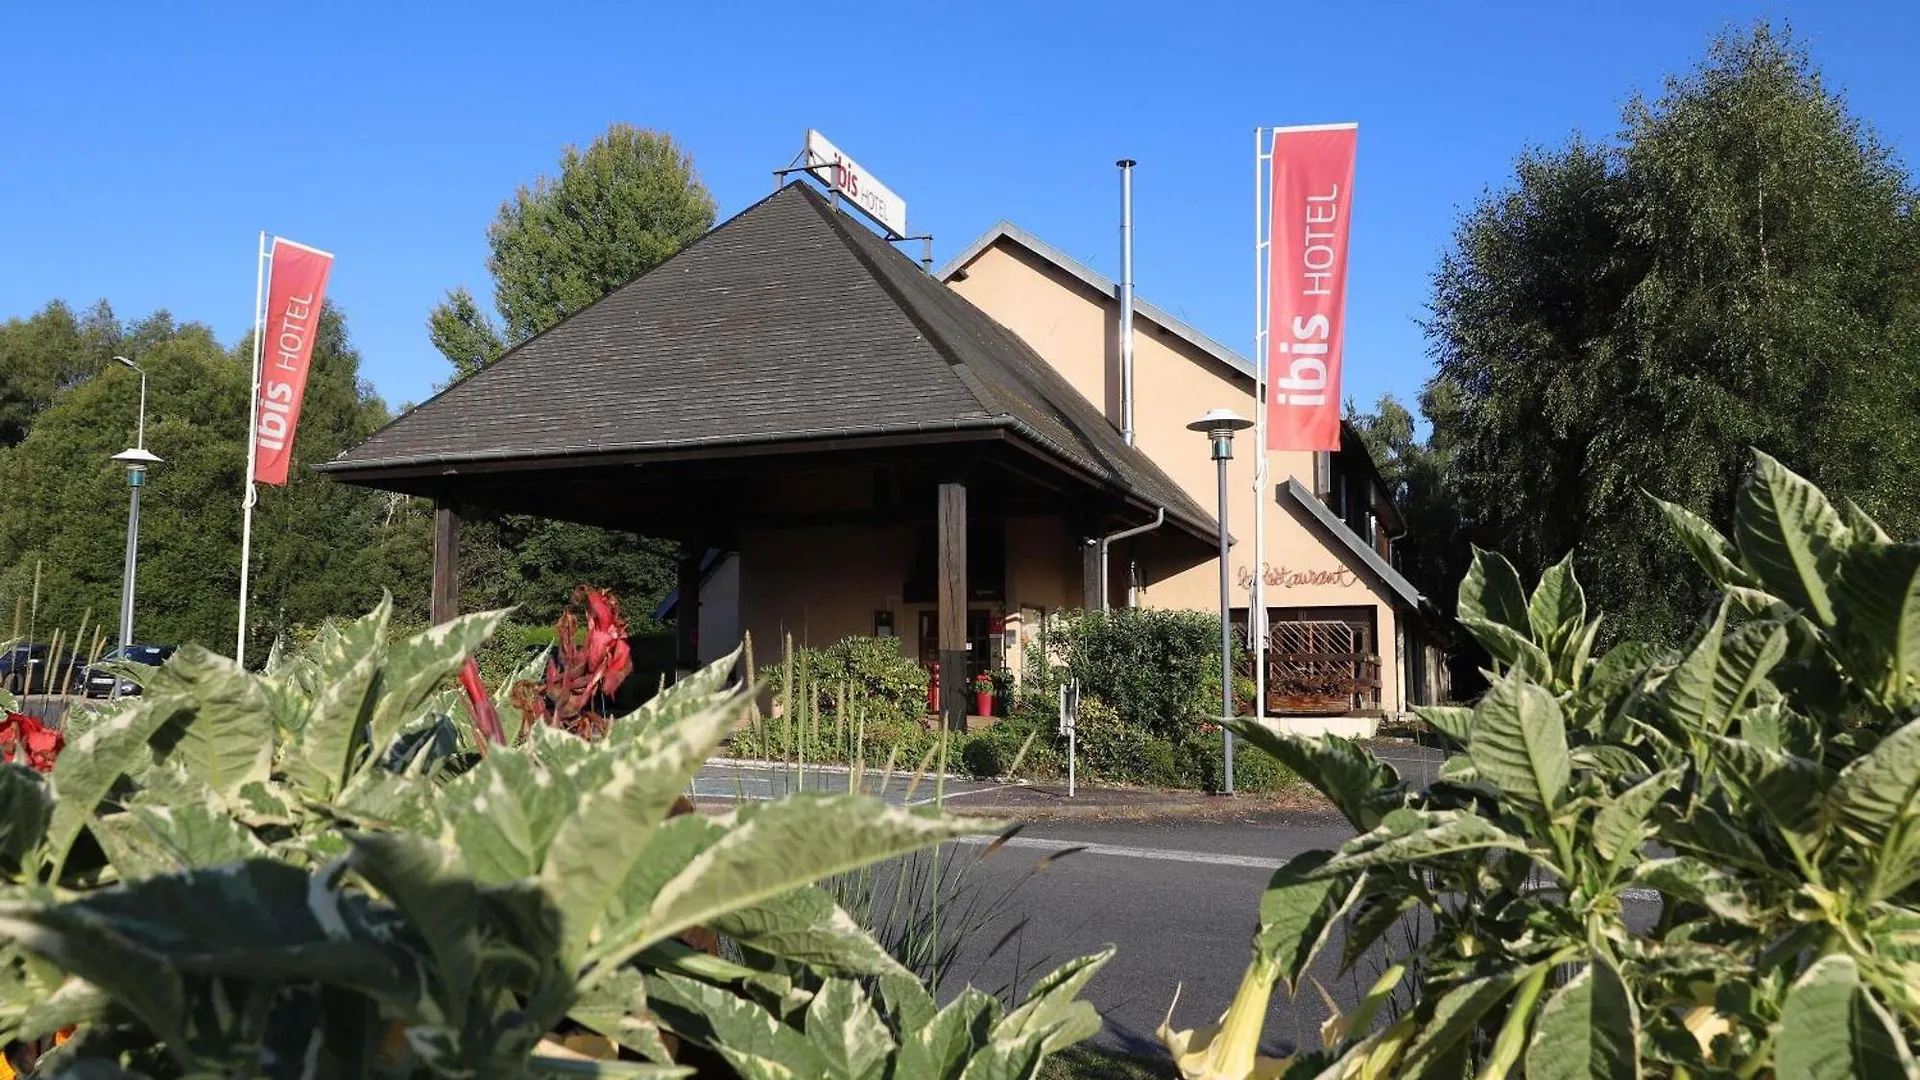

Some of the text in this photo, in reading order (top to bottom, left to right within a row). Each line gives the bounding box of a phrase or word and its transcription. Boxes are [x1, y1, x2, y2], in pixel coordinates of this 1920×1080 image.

[833, 152, 888, 221] bis HOTEL
[276, 292, 313, 372] HOTEL
[1277, 183, 1337, 406] ibis HOTEL
